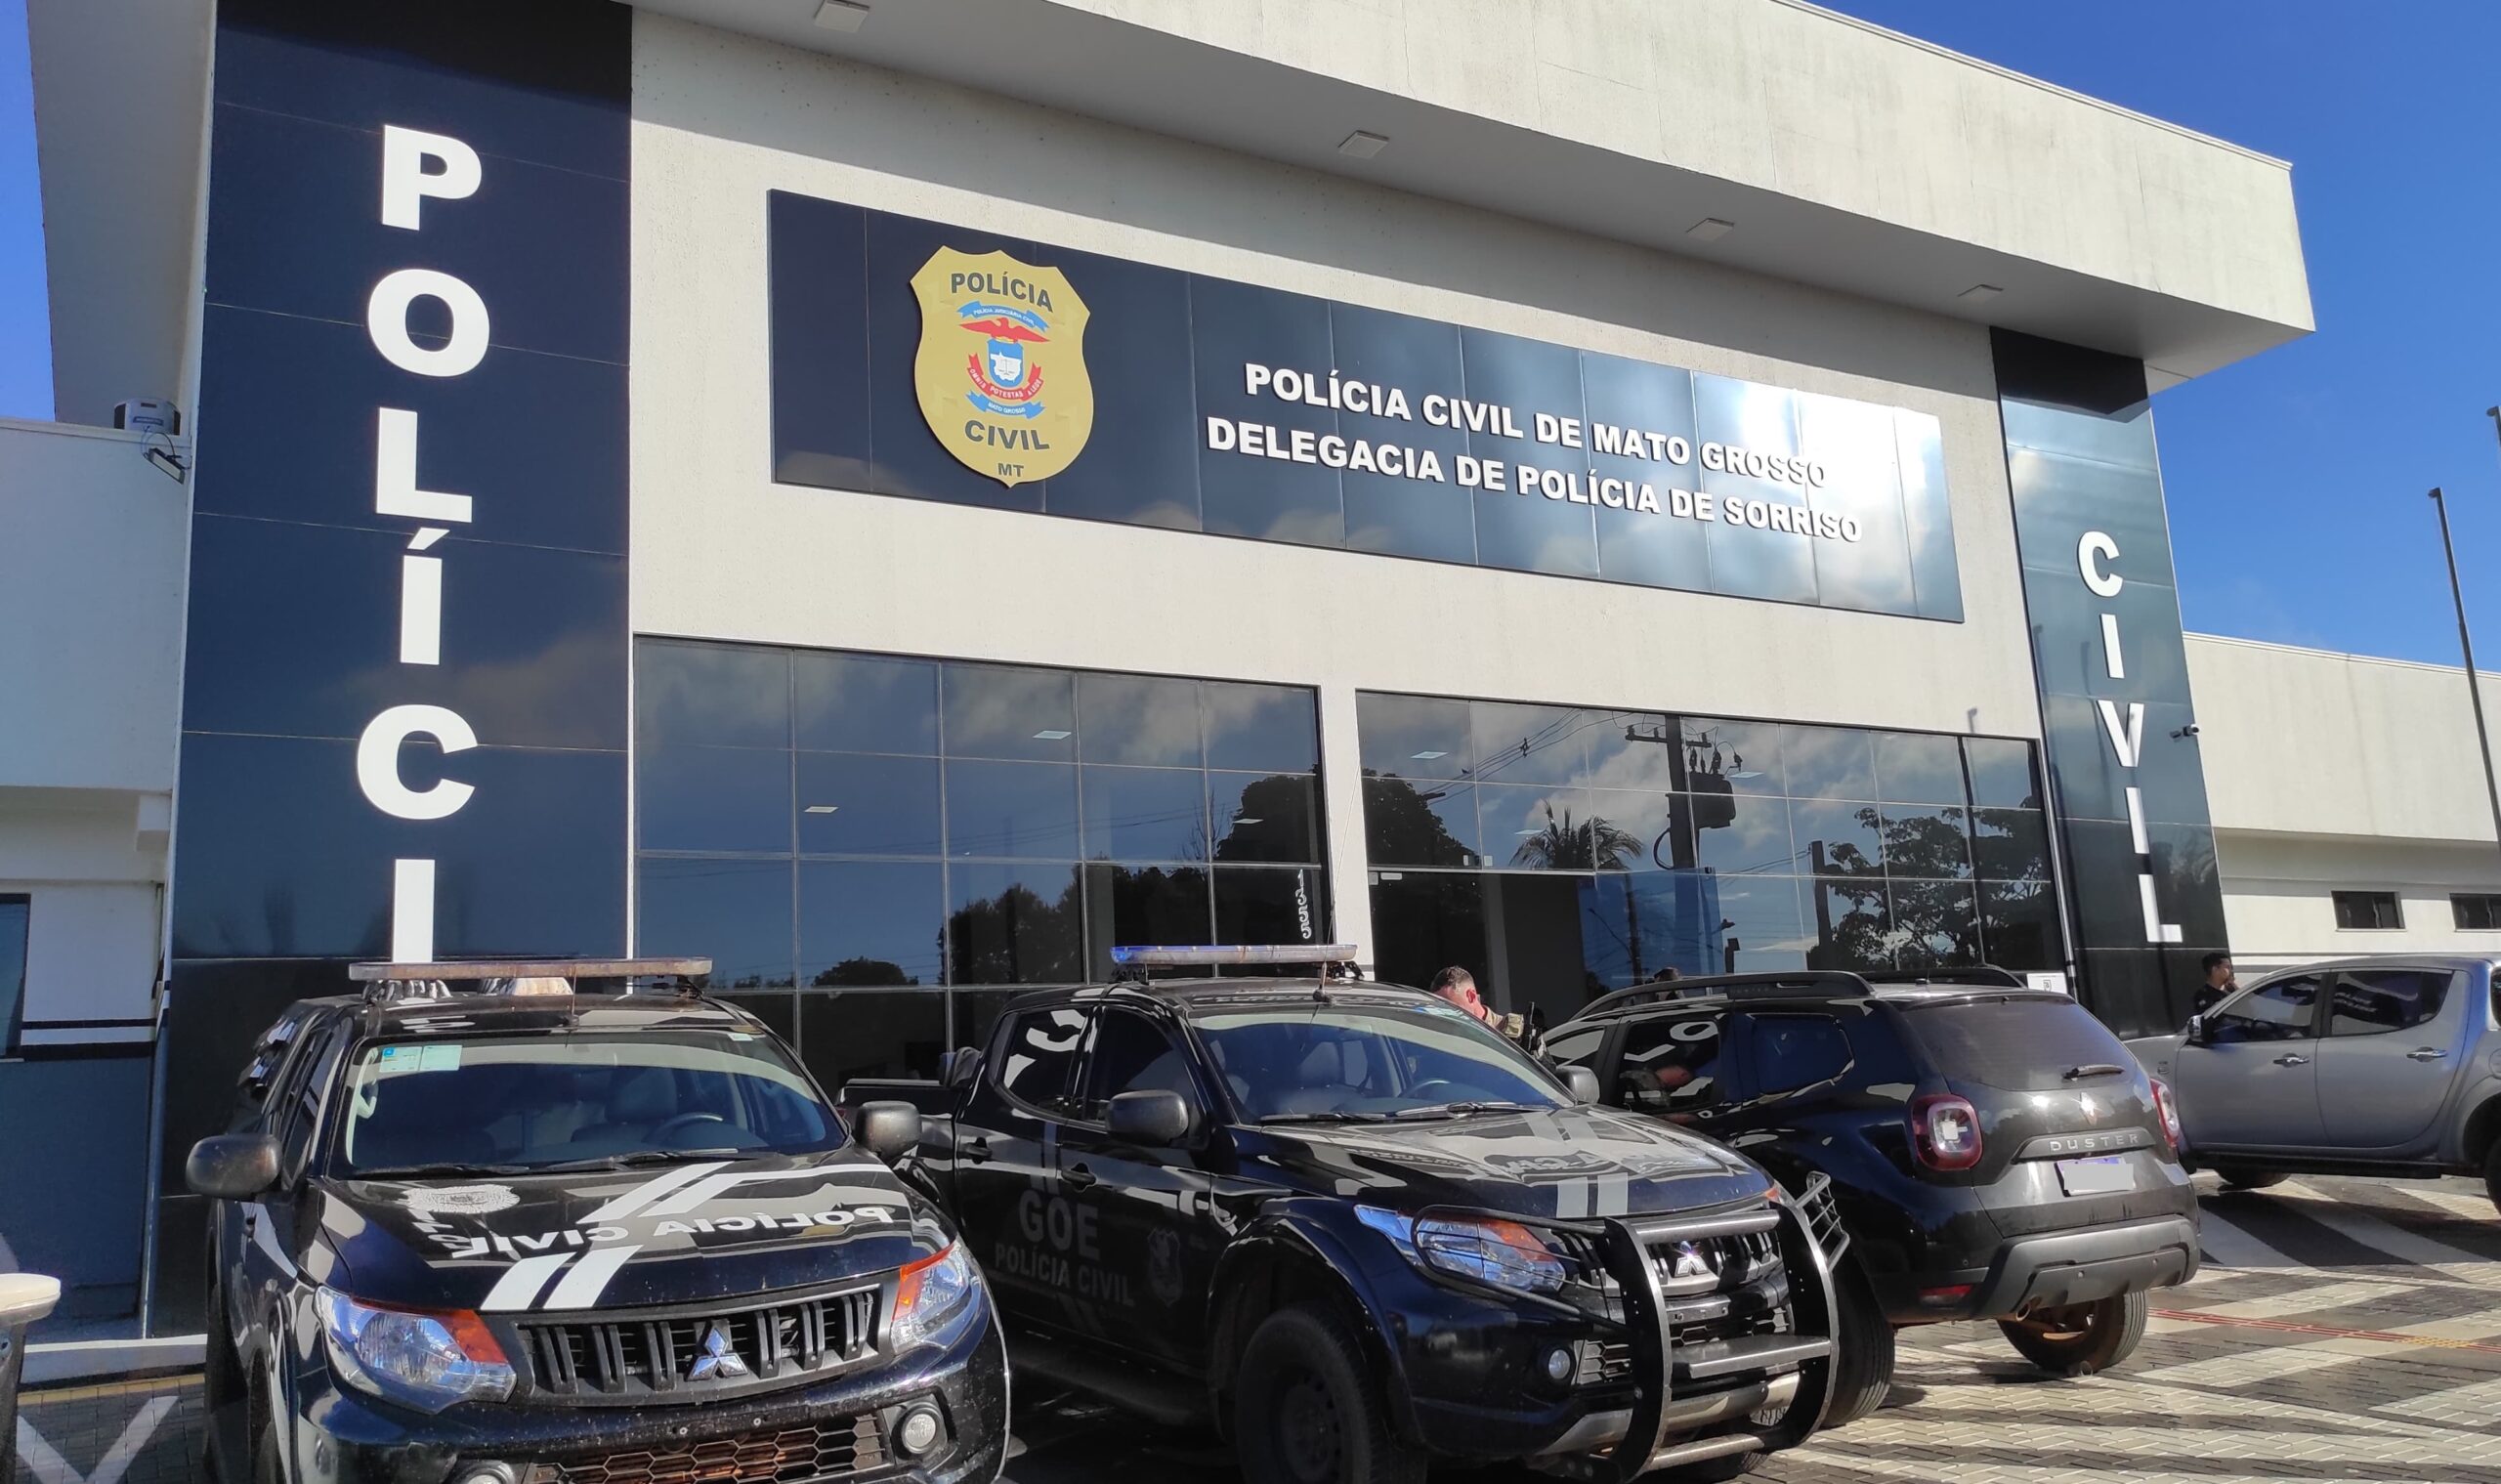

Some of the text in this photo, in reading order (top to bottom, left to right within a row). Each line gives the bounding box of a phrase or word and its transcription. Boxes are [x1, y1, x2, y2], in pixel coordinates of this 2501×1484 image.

[951, 272, 1053, 313] POLÍCIA
[970, 368, 987, 389] OMNIS
[990, 386, 1024, 399] POTESTAS
[988, 402, 1002, 411] MATO
[964, 420, 1050, 450] CIVIL
[1244, 362, 1826, 488] POLÍCIA CIVIL DE MATO GROSSO
[997, 463, 1024, 477] MT
[1207, 416, 1863, 544] DELEGACIA DE POLÍCIA DE SORRISO
[358, 124, 489, 963] POLÍCI
[2077, 530, 2183, 944] CIVIL
[1295, 869, 1312, 940] 1355
[2050, 1133, 2139, 1151] DUSTER
[1019, 1189, 1101, 1261] GOE
[995, 1242, 1136, 1307] POLÍCIA CIVIL
